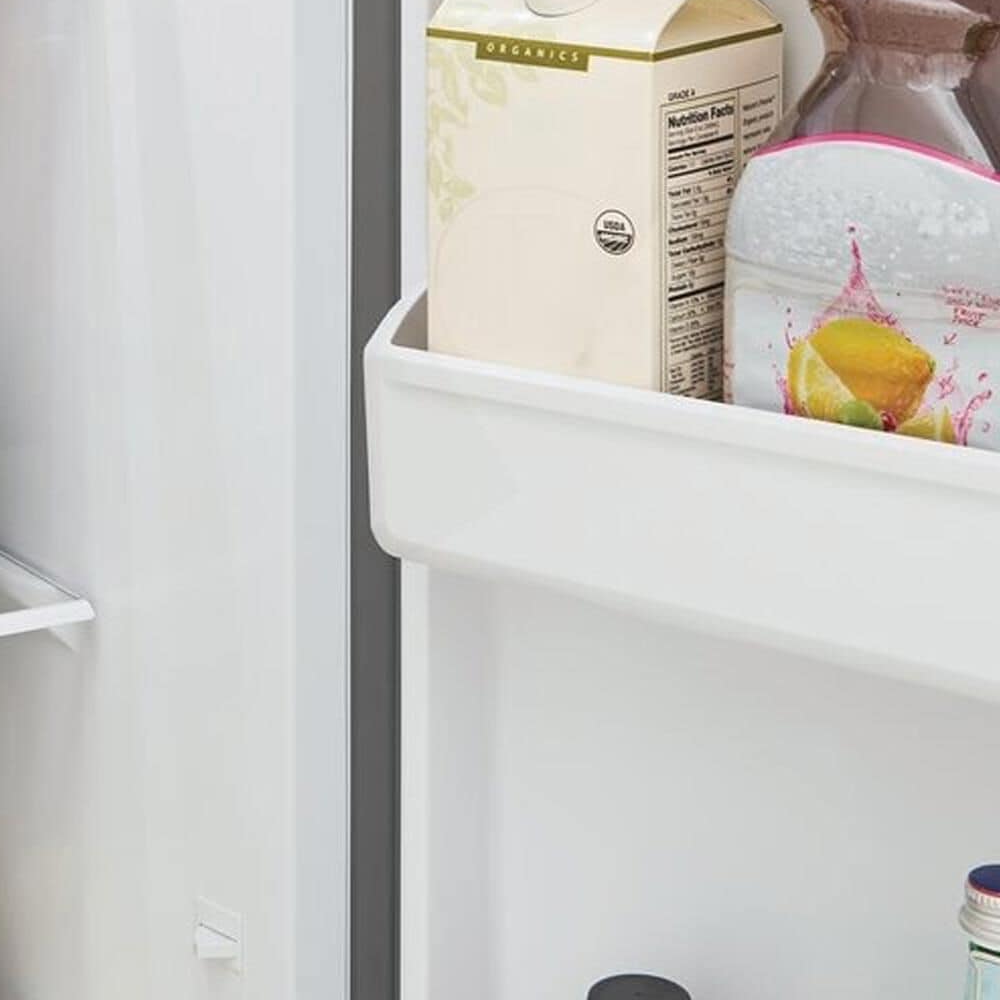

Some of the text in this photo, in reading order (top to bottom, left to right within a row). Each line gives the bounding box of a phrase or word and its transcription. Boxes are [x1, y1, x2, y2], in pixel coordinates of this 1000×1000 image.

[486, 42, 579, 63] ORGANICS
[668, 110, 709, 128] Nutrition
[710, 104, 735, 120] Facts
